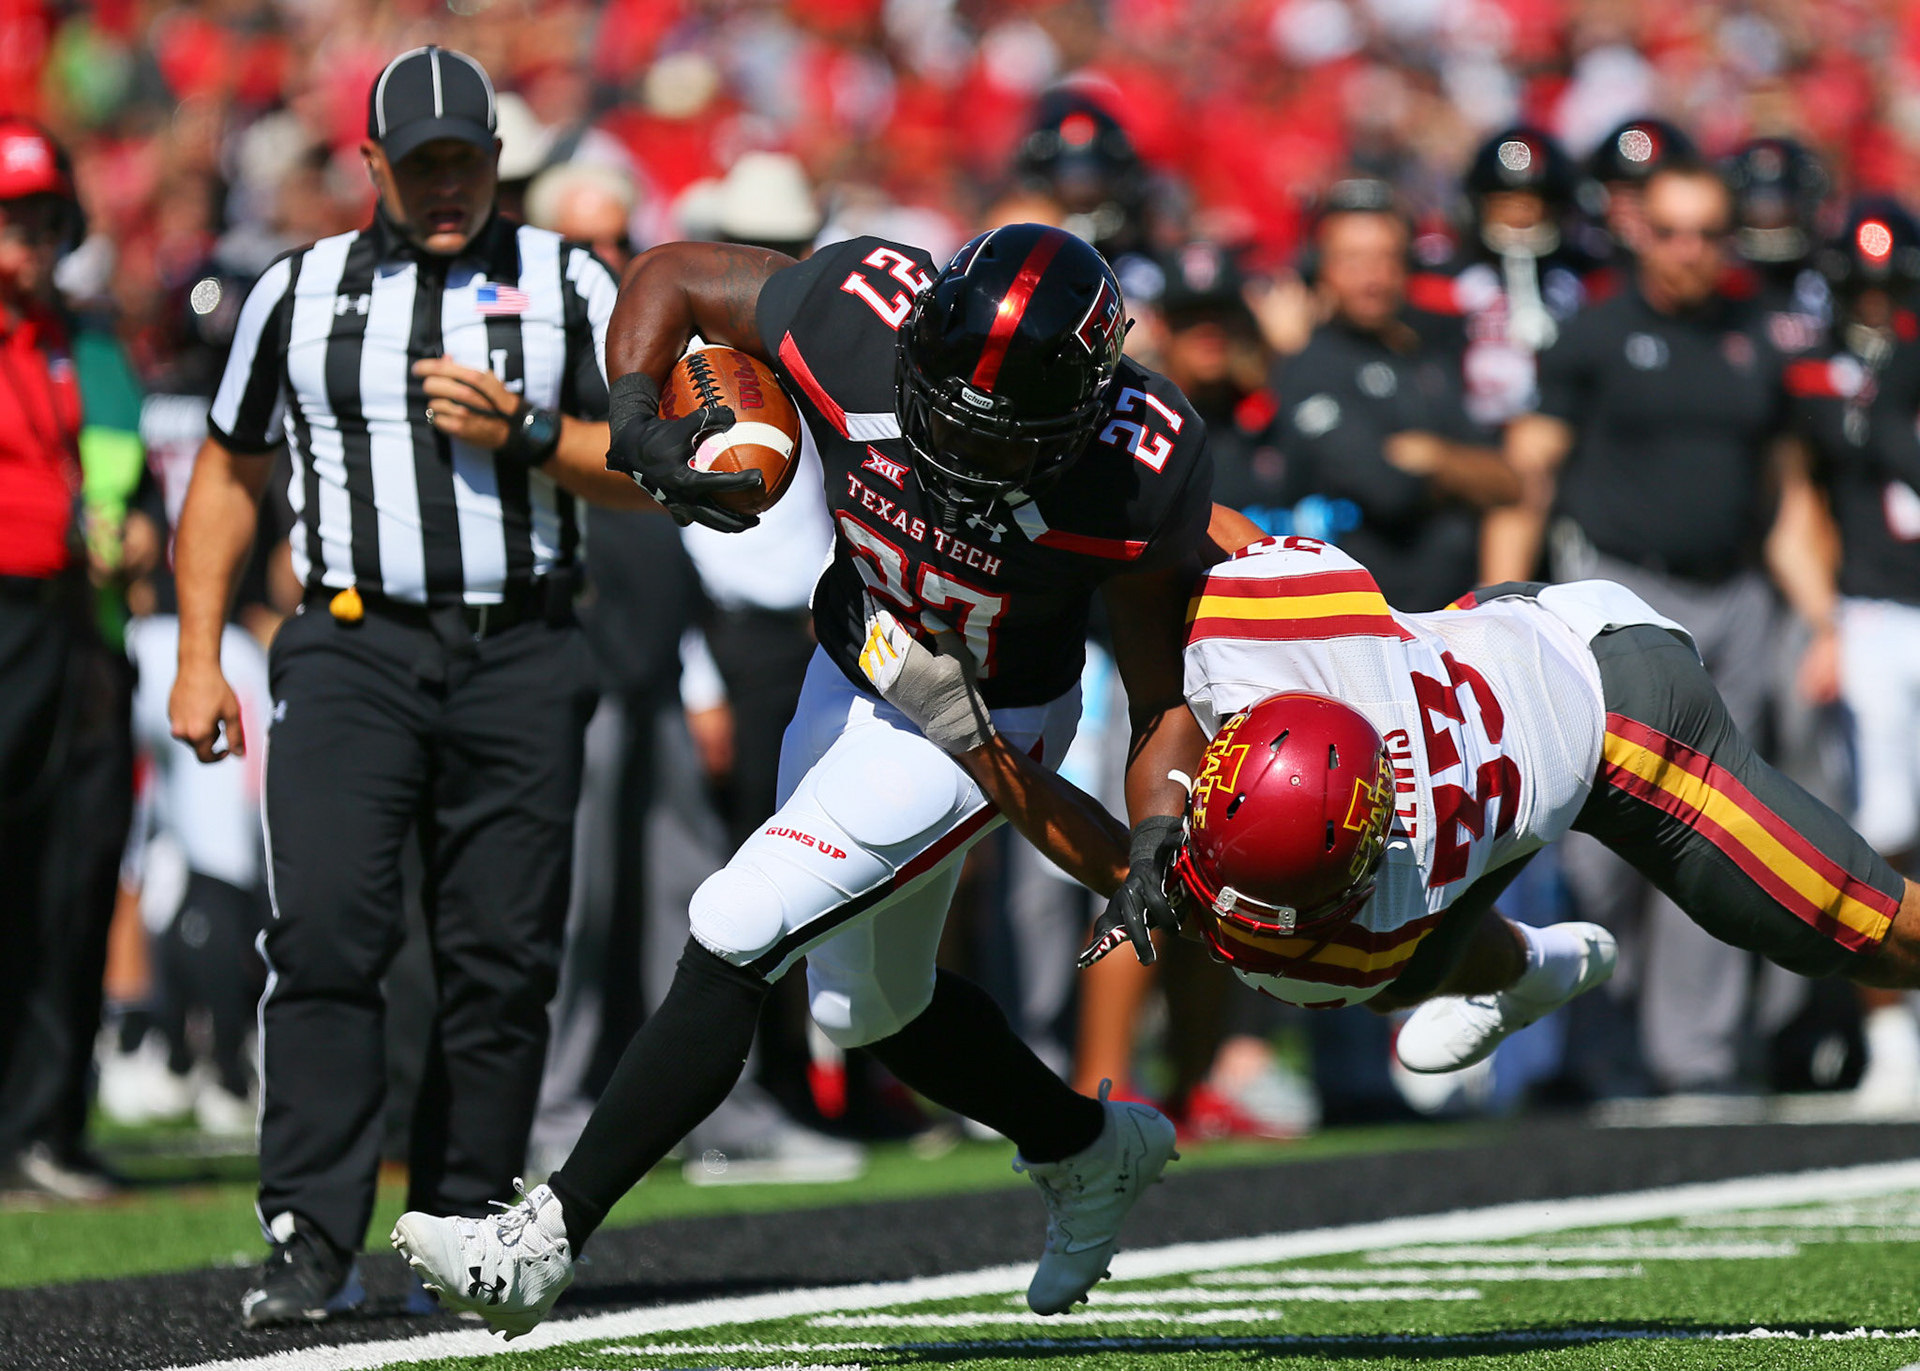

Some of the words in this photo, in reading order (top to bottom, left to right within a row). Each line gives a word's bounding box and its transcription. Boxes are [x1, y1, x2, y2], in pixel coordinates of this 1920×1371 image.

[840, 246, 934, 331] 27
[1098, 386, 1184, 474] 27
[846, 471, 927, 543] TEXAS
[932, 527, 1002, 576] TECH
[1193, 714, 1246, 829] STATE
[1410, 651, 1521, 888] 33
[765, 826, 816, 847] GUNS
[818, 840, 847, 859] UP
